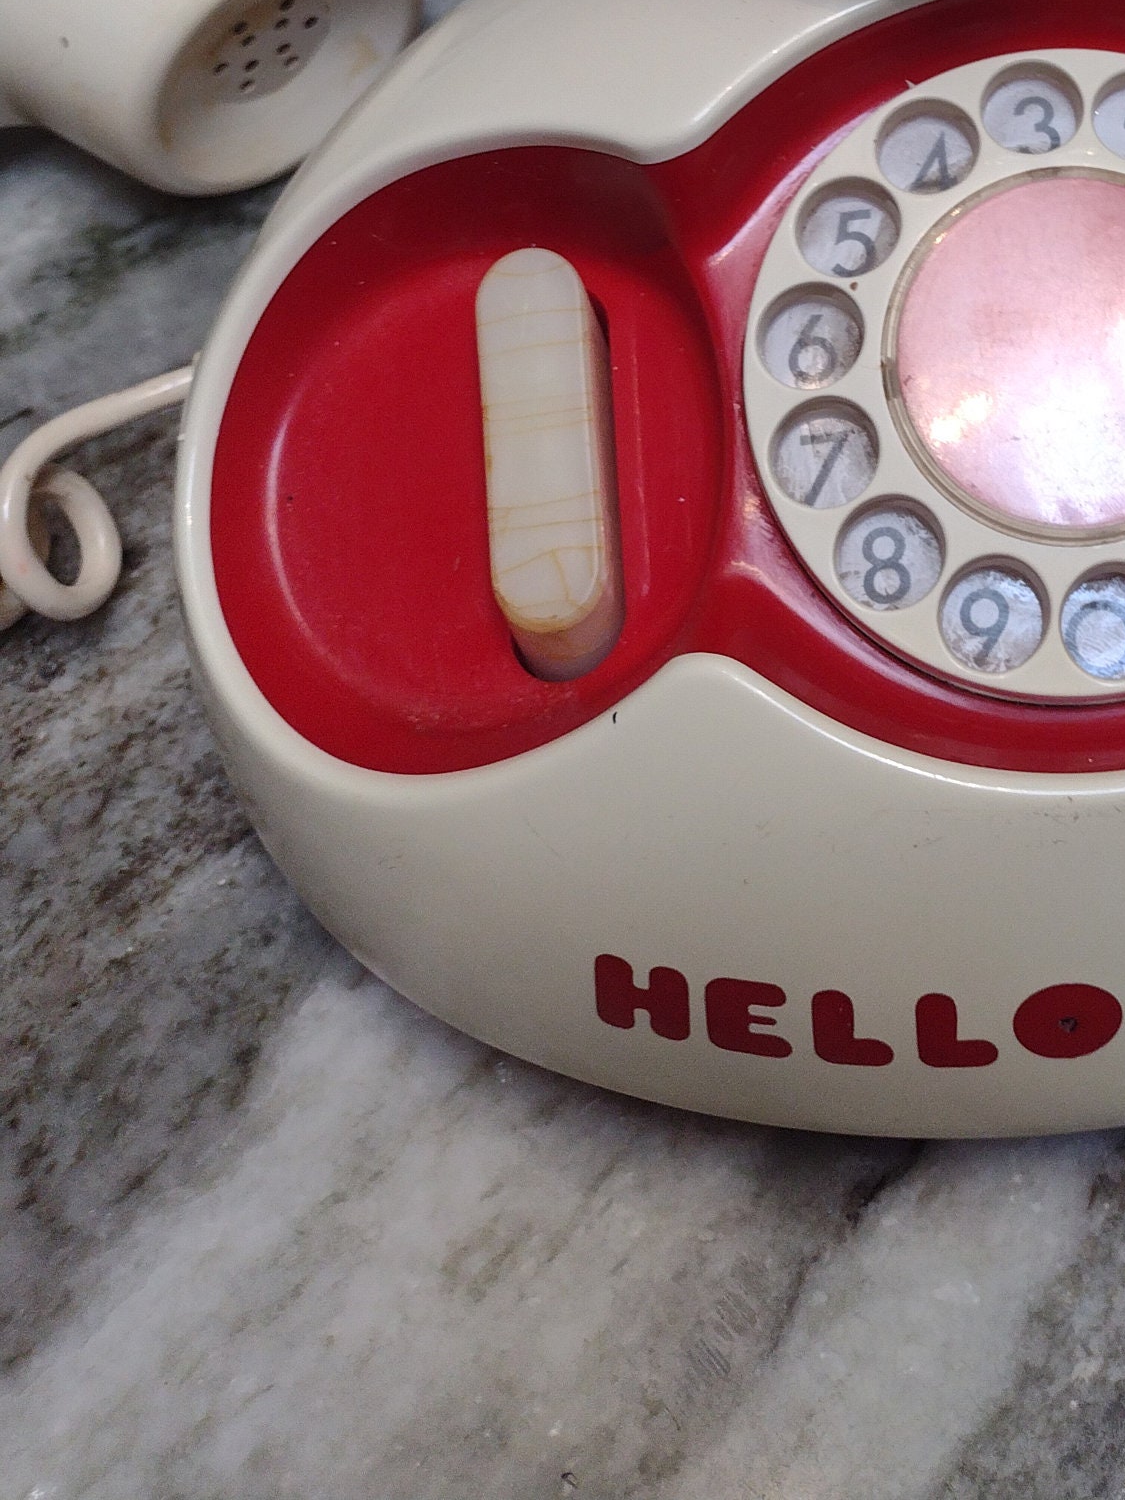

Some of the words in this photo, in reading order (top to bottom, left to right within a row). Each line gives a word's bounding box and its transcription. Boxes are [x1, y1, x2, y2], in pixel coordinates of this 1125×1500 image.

[1013, 96, 1061, 153] 3
[908, 131, 958, 192] 4
[832, 209, 875, 277] 5
[789, 314, 837, 381] 6
[799, 430, 850, 507] 7
[862, 526, 912, 605] 8
[959, 587, 1010, 666] 9
[594, 954, 1122, 1068] HELLO
